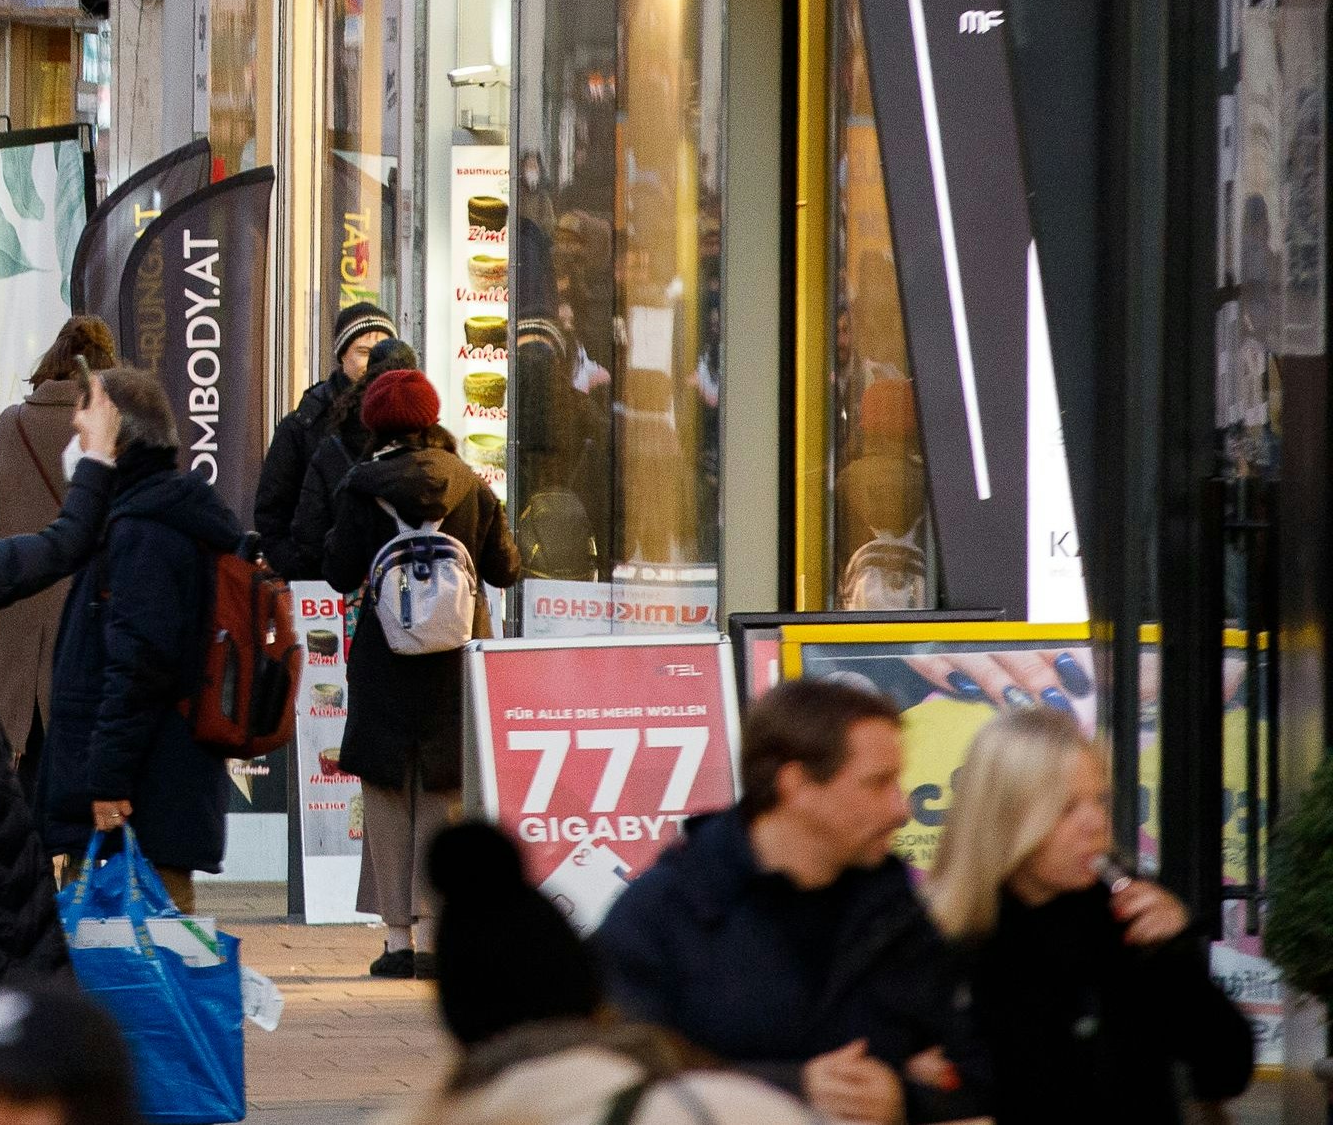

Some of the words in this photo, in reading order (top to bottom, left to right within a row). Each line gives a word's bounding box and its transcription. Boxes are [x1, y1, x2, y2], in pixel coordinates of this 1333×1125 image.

[505, 707, 533, 720] FÜR
[537, 707, 573, 720] ALLE
[575, 707, 600, 719] DIE
[602, 706, 643, 718] MEHR
[646, 704, 707, 717] WOLLEN
[508, 727, 709, 814] 777
[518, 813, 689, 843] GIGABYT
